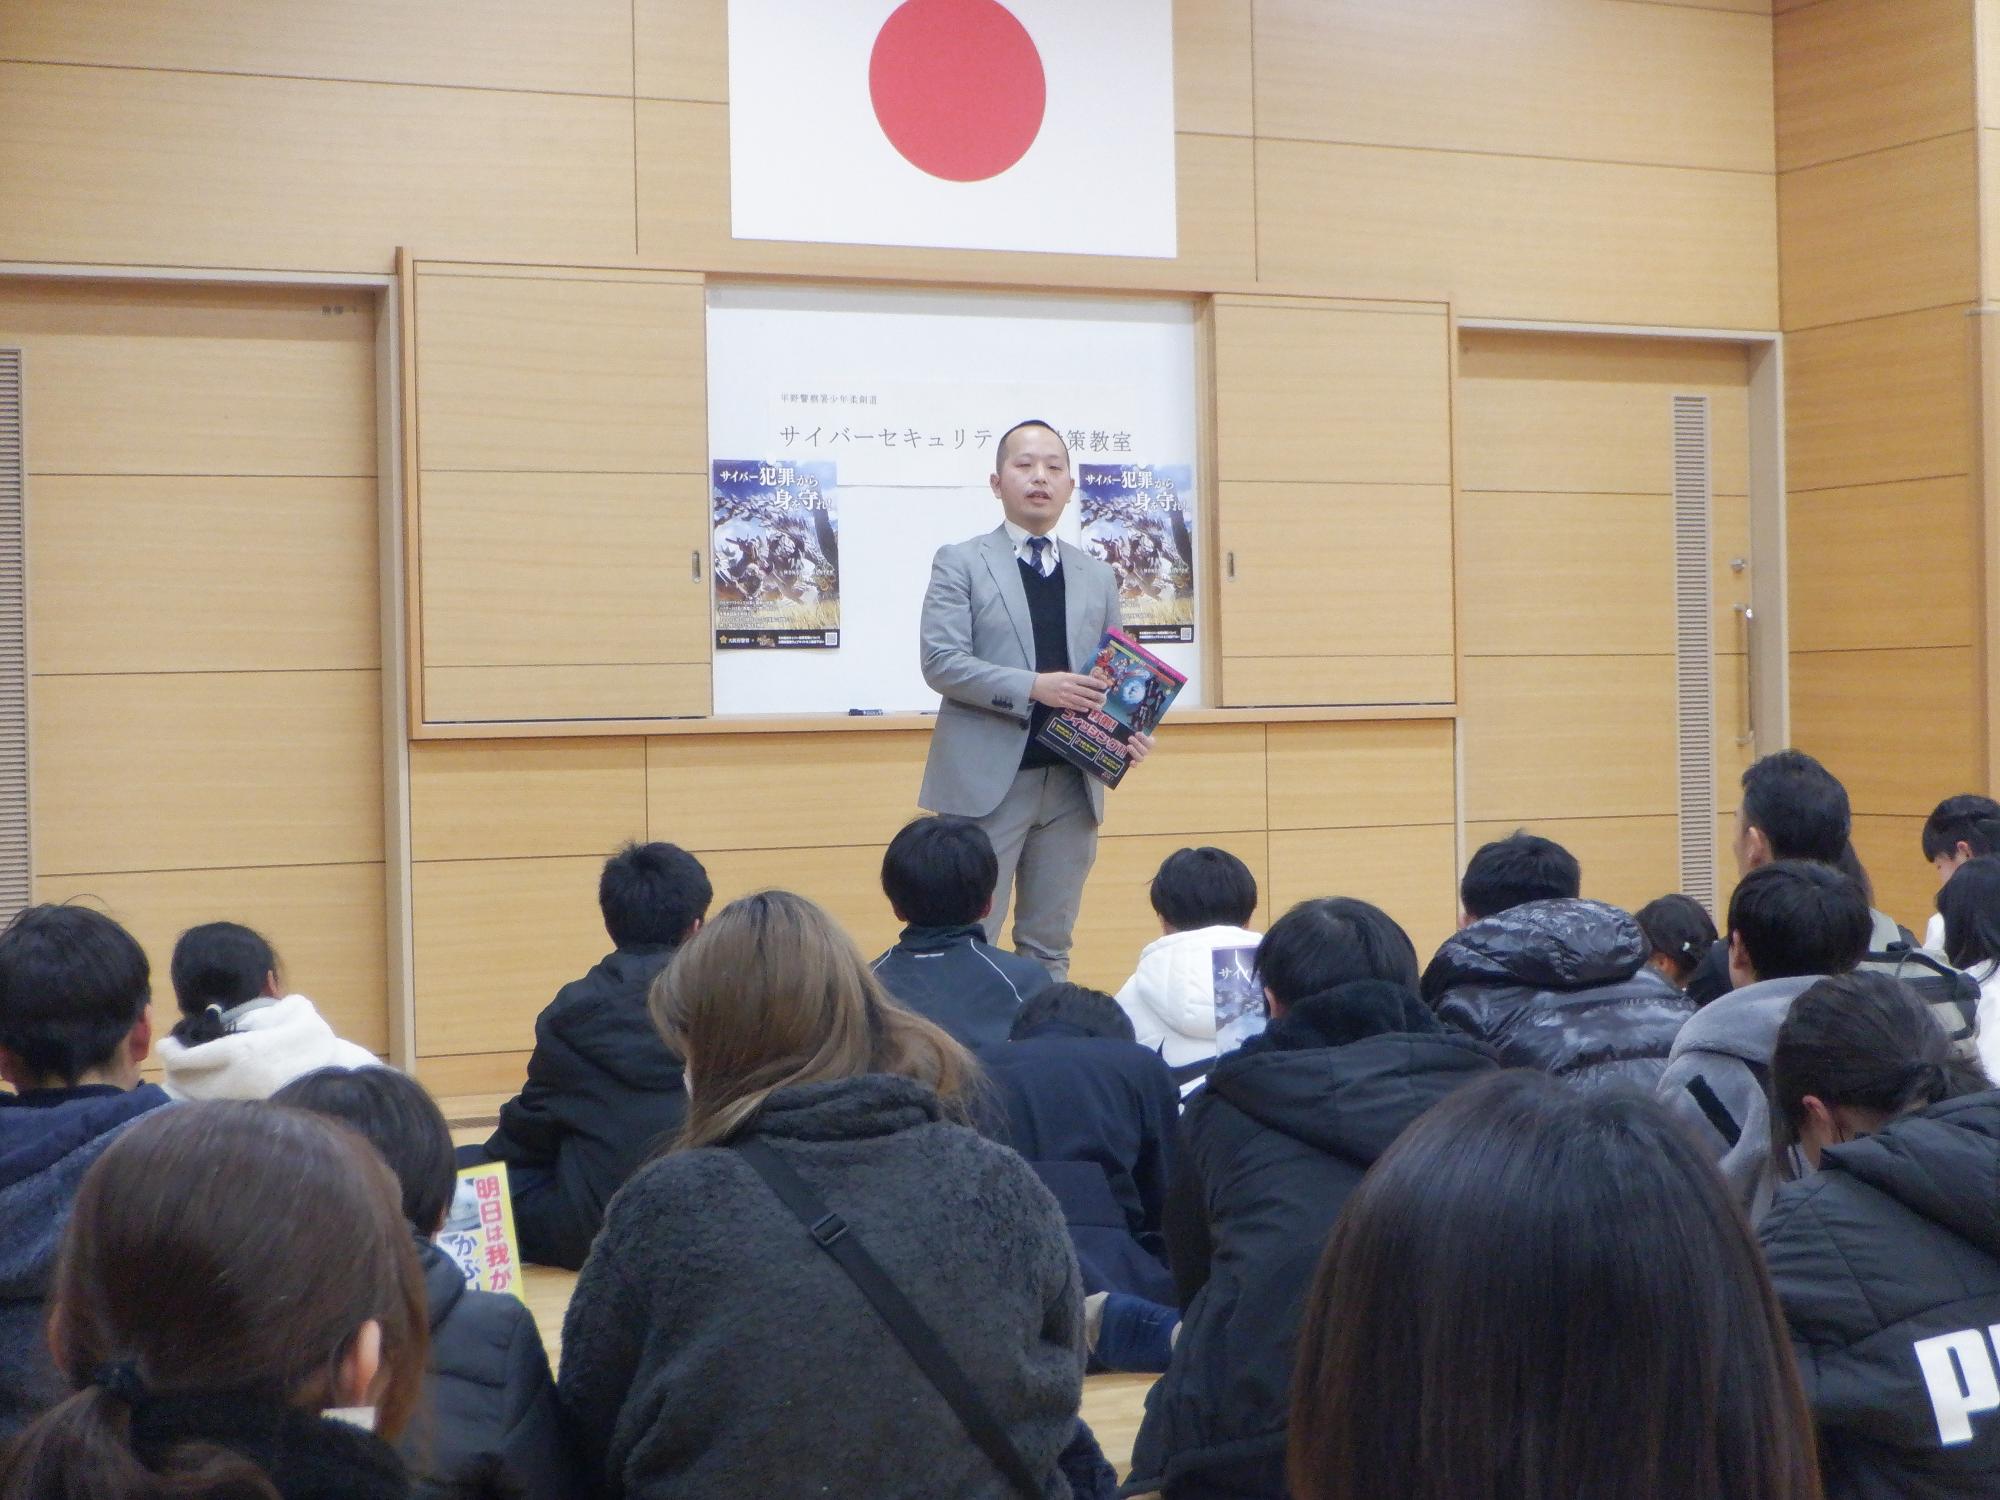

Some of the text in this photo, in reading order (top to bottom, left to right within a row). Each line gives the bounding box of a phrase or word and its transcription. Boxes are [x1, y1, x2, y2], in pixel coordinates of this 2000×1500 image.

[720, 467, 818, 487] サイバー犯罪から
[1085, 470, 1174, 489] サイバー犯罪から
